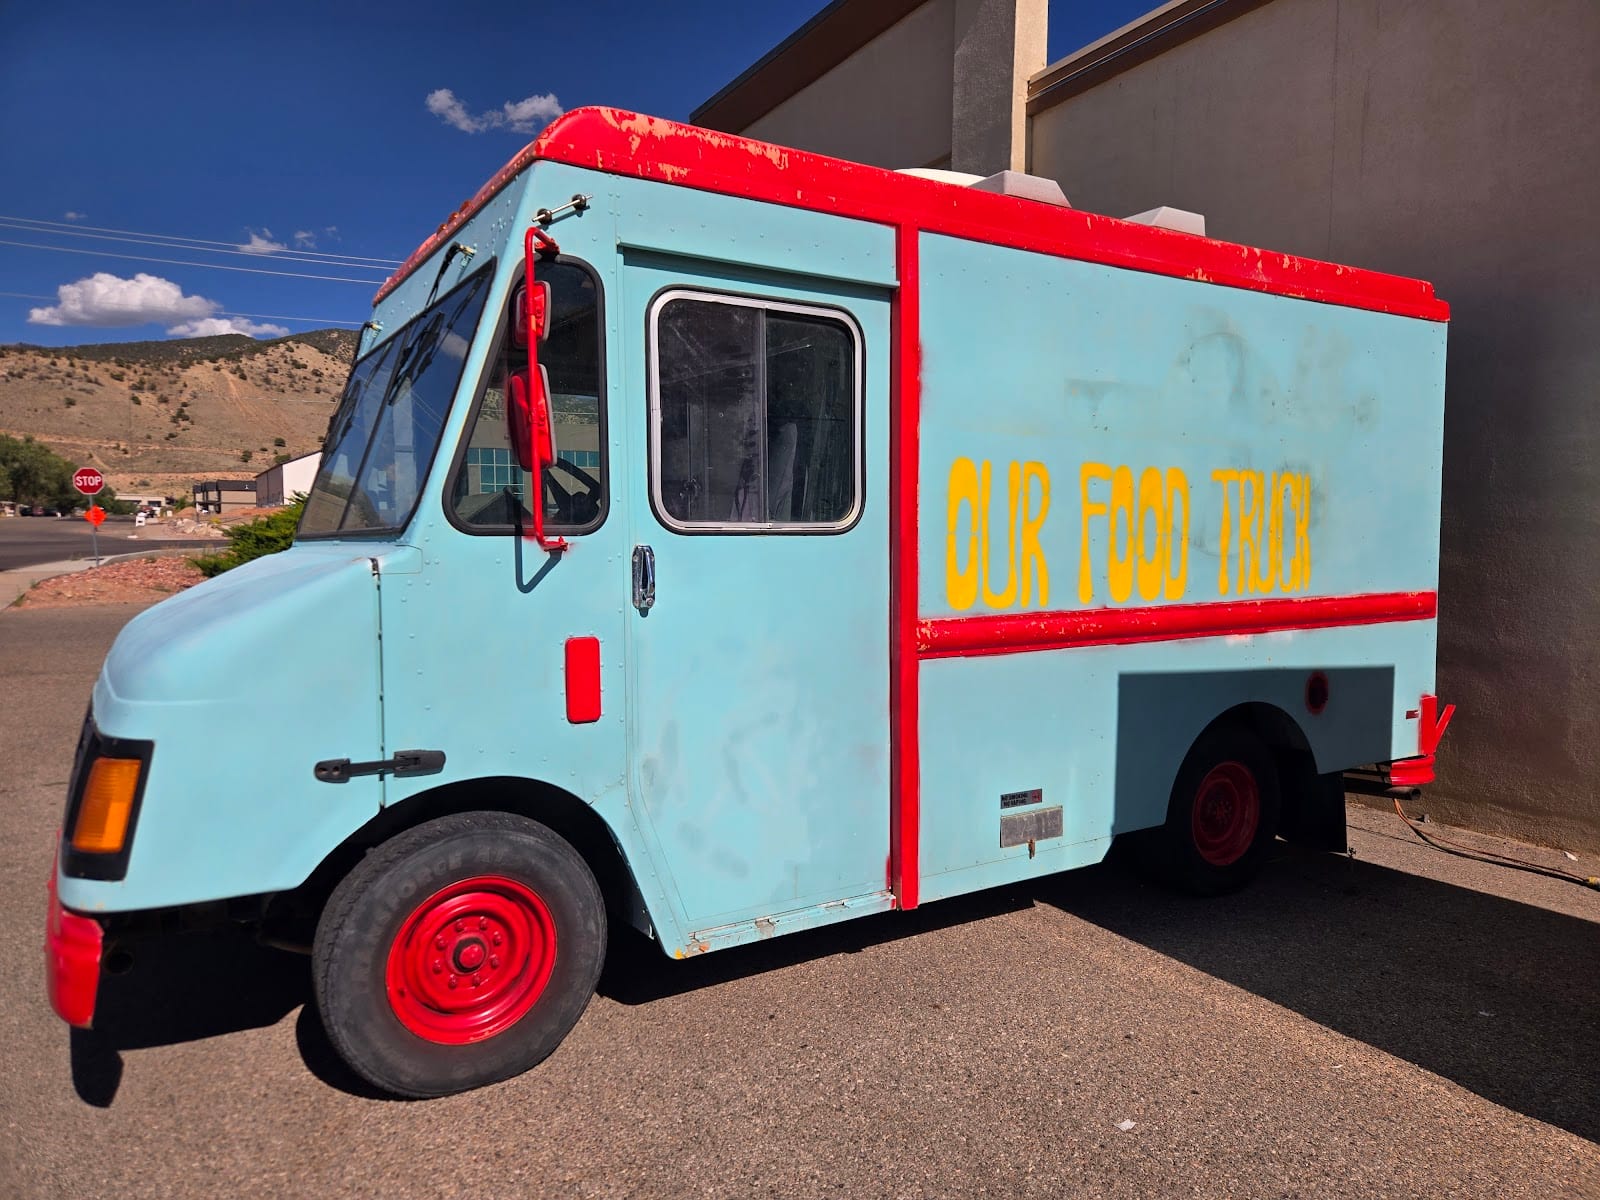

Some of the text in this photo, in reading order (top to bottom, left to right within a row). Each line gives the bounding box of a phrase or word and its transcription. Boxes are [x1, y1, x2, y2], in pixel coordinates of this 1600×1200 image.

[76, 476, 101, 486] STOP
[946, 457, 1312, 611] OUR FOOD TRUCK
